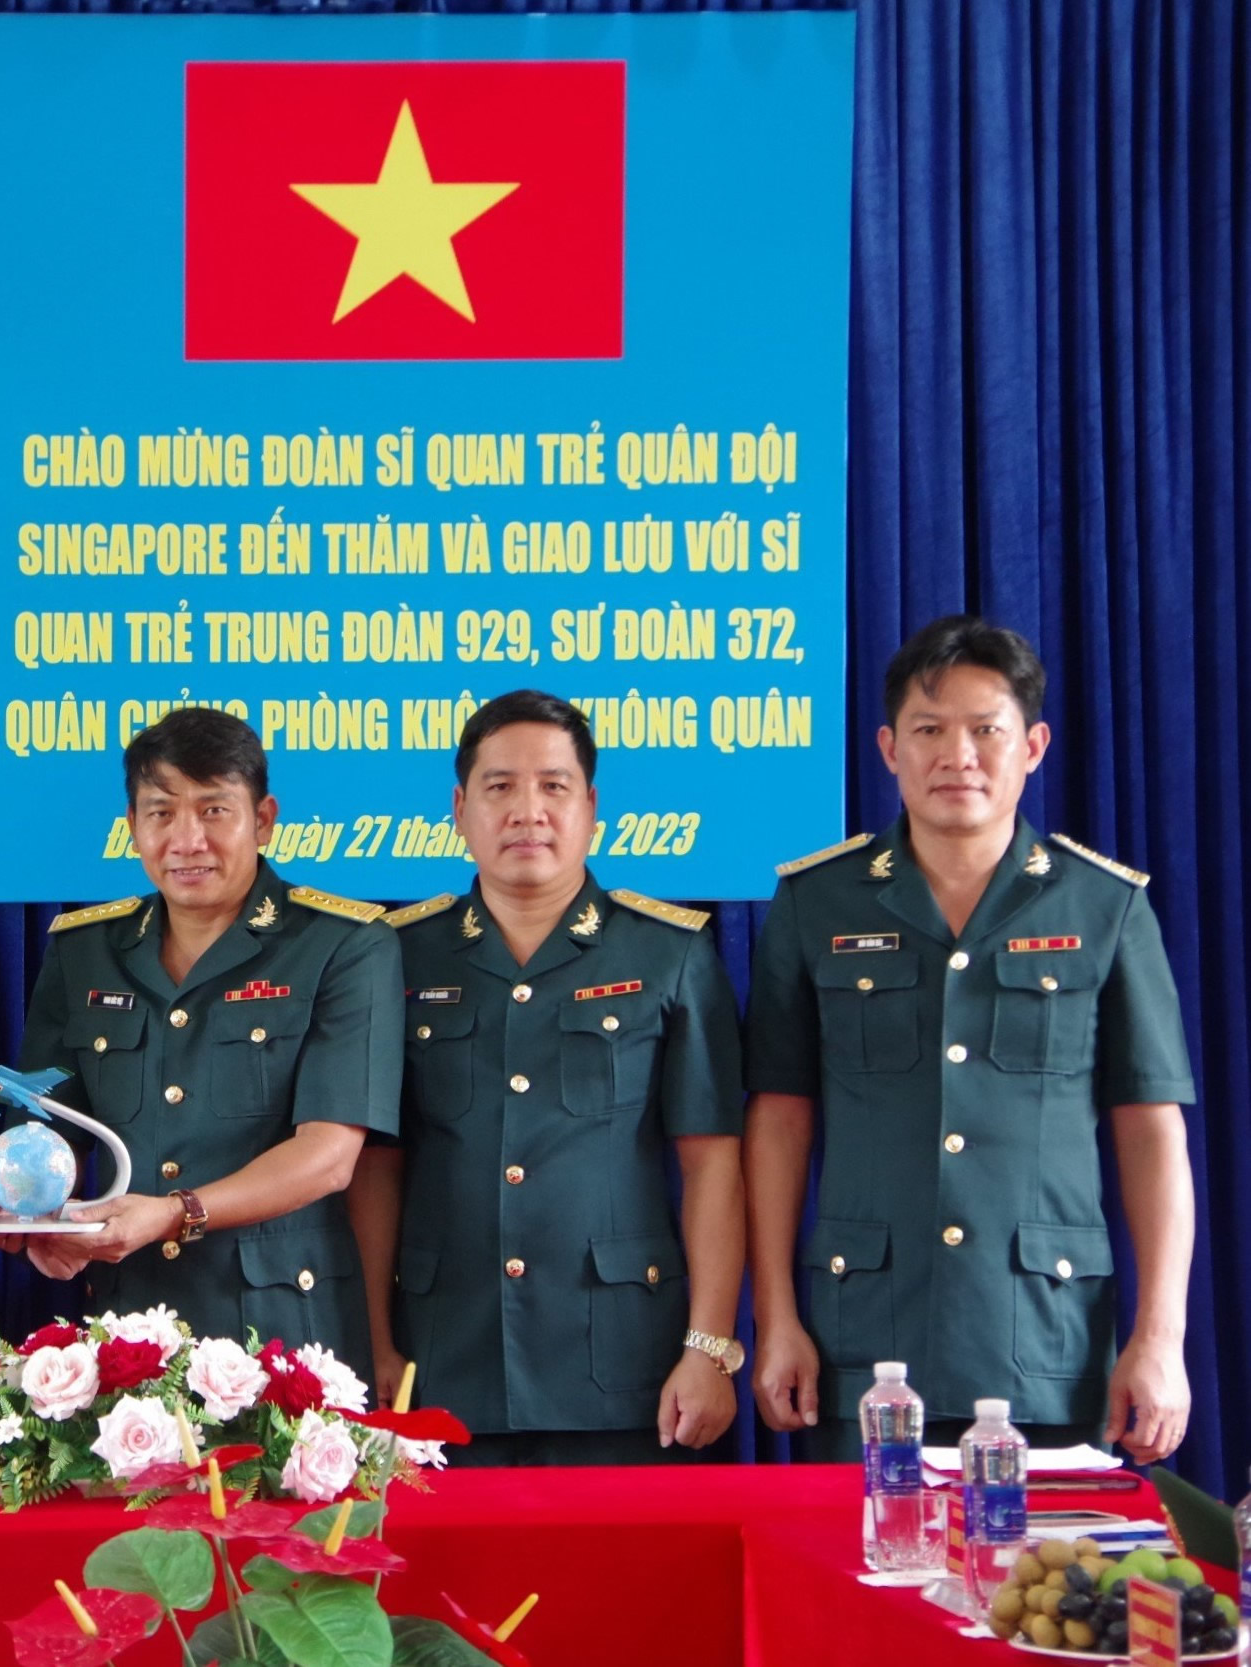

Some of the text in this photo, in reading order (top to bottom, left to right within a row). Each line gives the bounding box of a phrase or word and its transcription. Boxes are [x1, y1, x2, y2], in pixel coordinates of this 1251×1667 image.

[24, 421, 796, 492] CHÀO MỪNG ĐOÀN SĨ QUAN TRẺ QUÂN ĐỘI
[19, 505, 801, 576] SINGAPORE ĐẾN THĂM VÀ GIAO LƯU VỚI SĨ
[15, 598, 804, 669] QUAN TRẺ TRUNG ĐOÀN 929, SƯ ĐOÀN 372,
[5, 691, 106, 757] QUÂN
[261, 691, 388, 751] PHÒNG
[711, 687, 812, 753] QUÂN
[343, 815, 392, 858] 27
[608, 812, 701, 857] 2023
